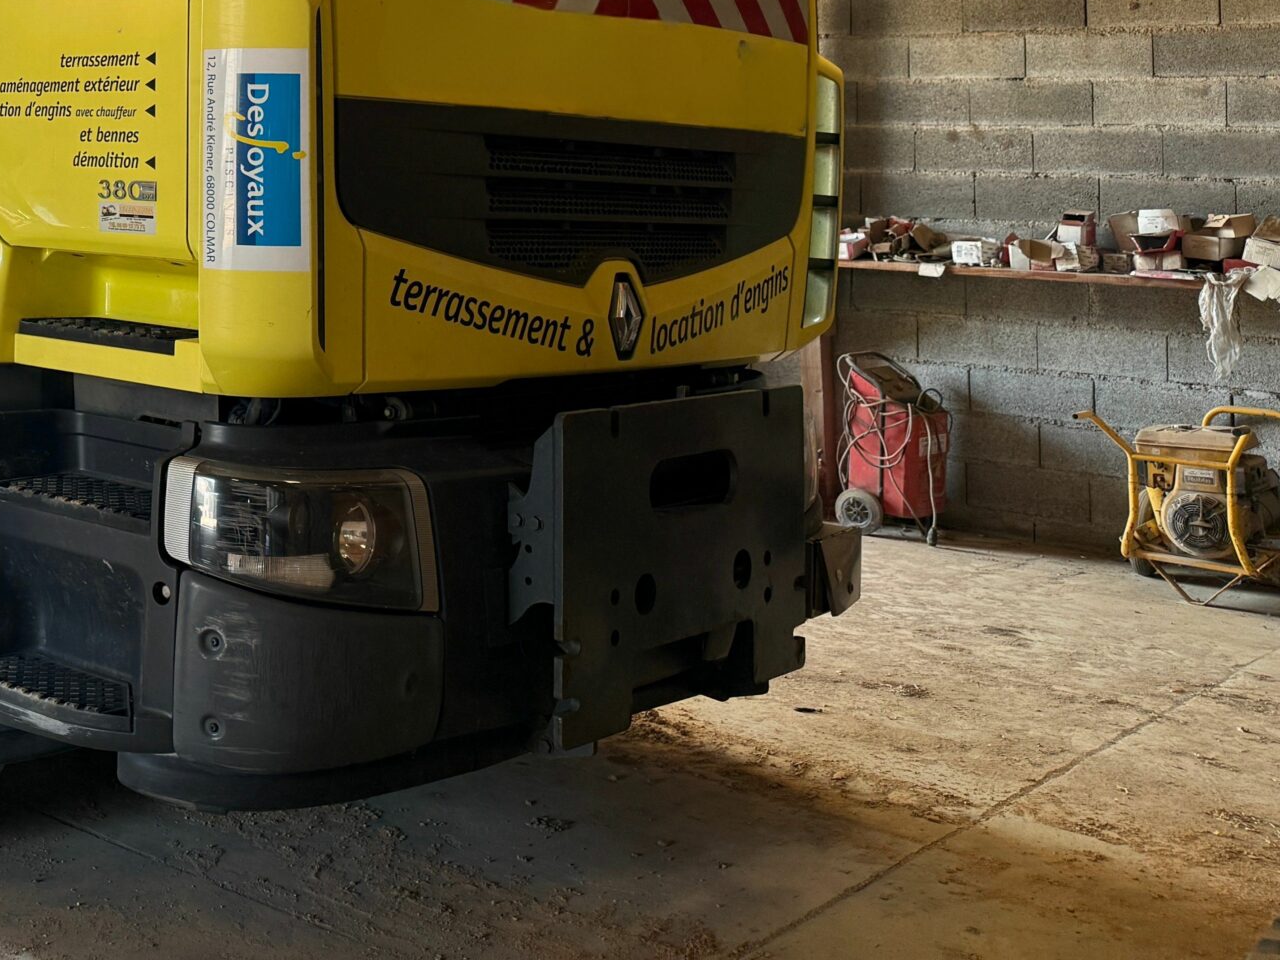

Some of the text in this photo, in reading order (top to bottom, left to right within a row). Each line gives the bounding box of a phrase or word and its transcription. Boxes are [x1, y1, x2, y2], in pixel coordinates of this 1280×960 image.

[60, 51, 140, 68] terrassement
[0, 76, 140, 97] aménagement extérieur
[25, 101, 72, 121] d'engins
[75, 108, 94, 118] avec
[95, 106, 137, 120] chauffeur
[79, 127, 139, 143] et bennes
[73, 152, 139, 169] démolition
[205, 55, 216, 263] 12, Rue André Kiener, 68000 COLMAR
[224, 82, 307, 237] Desjoyaux
[98, 179, 141, 200] 380
[224, 147, 235, 236] PISCINES
[389, 265, 789, 357] terrassement & location d'engins
